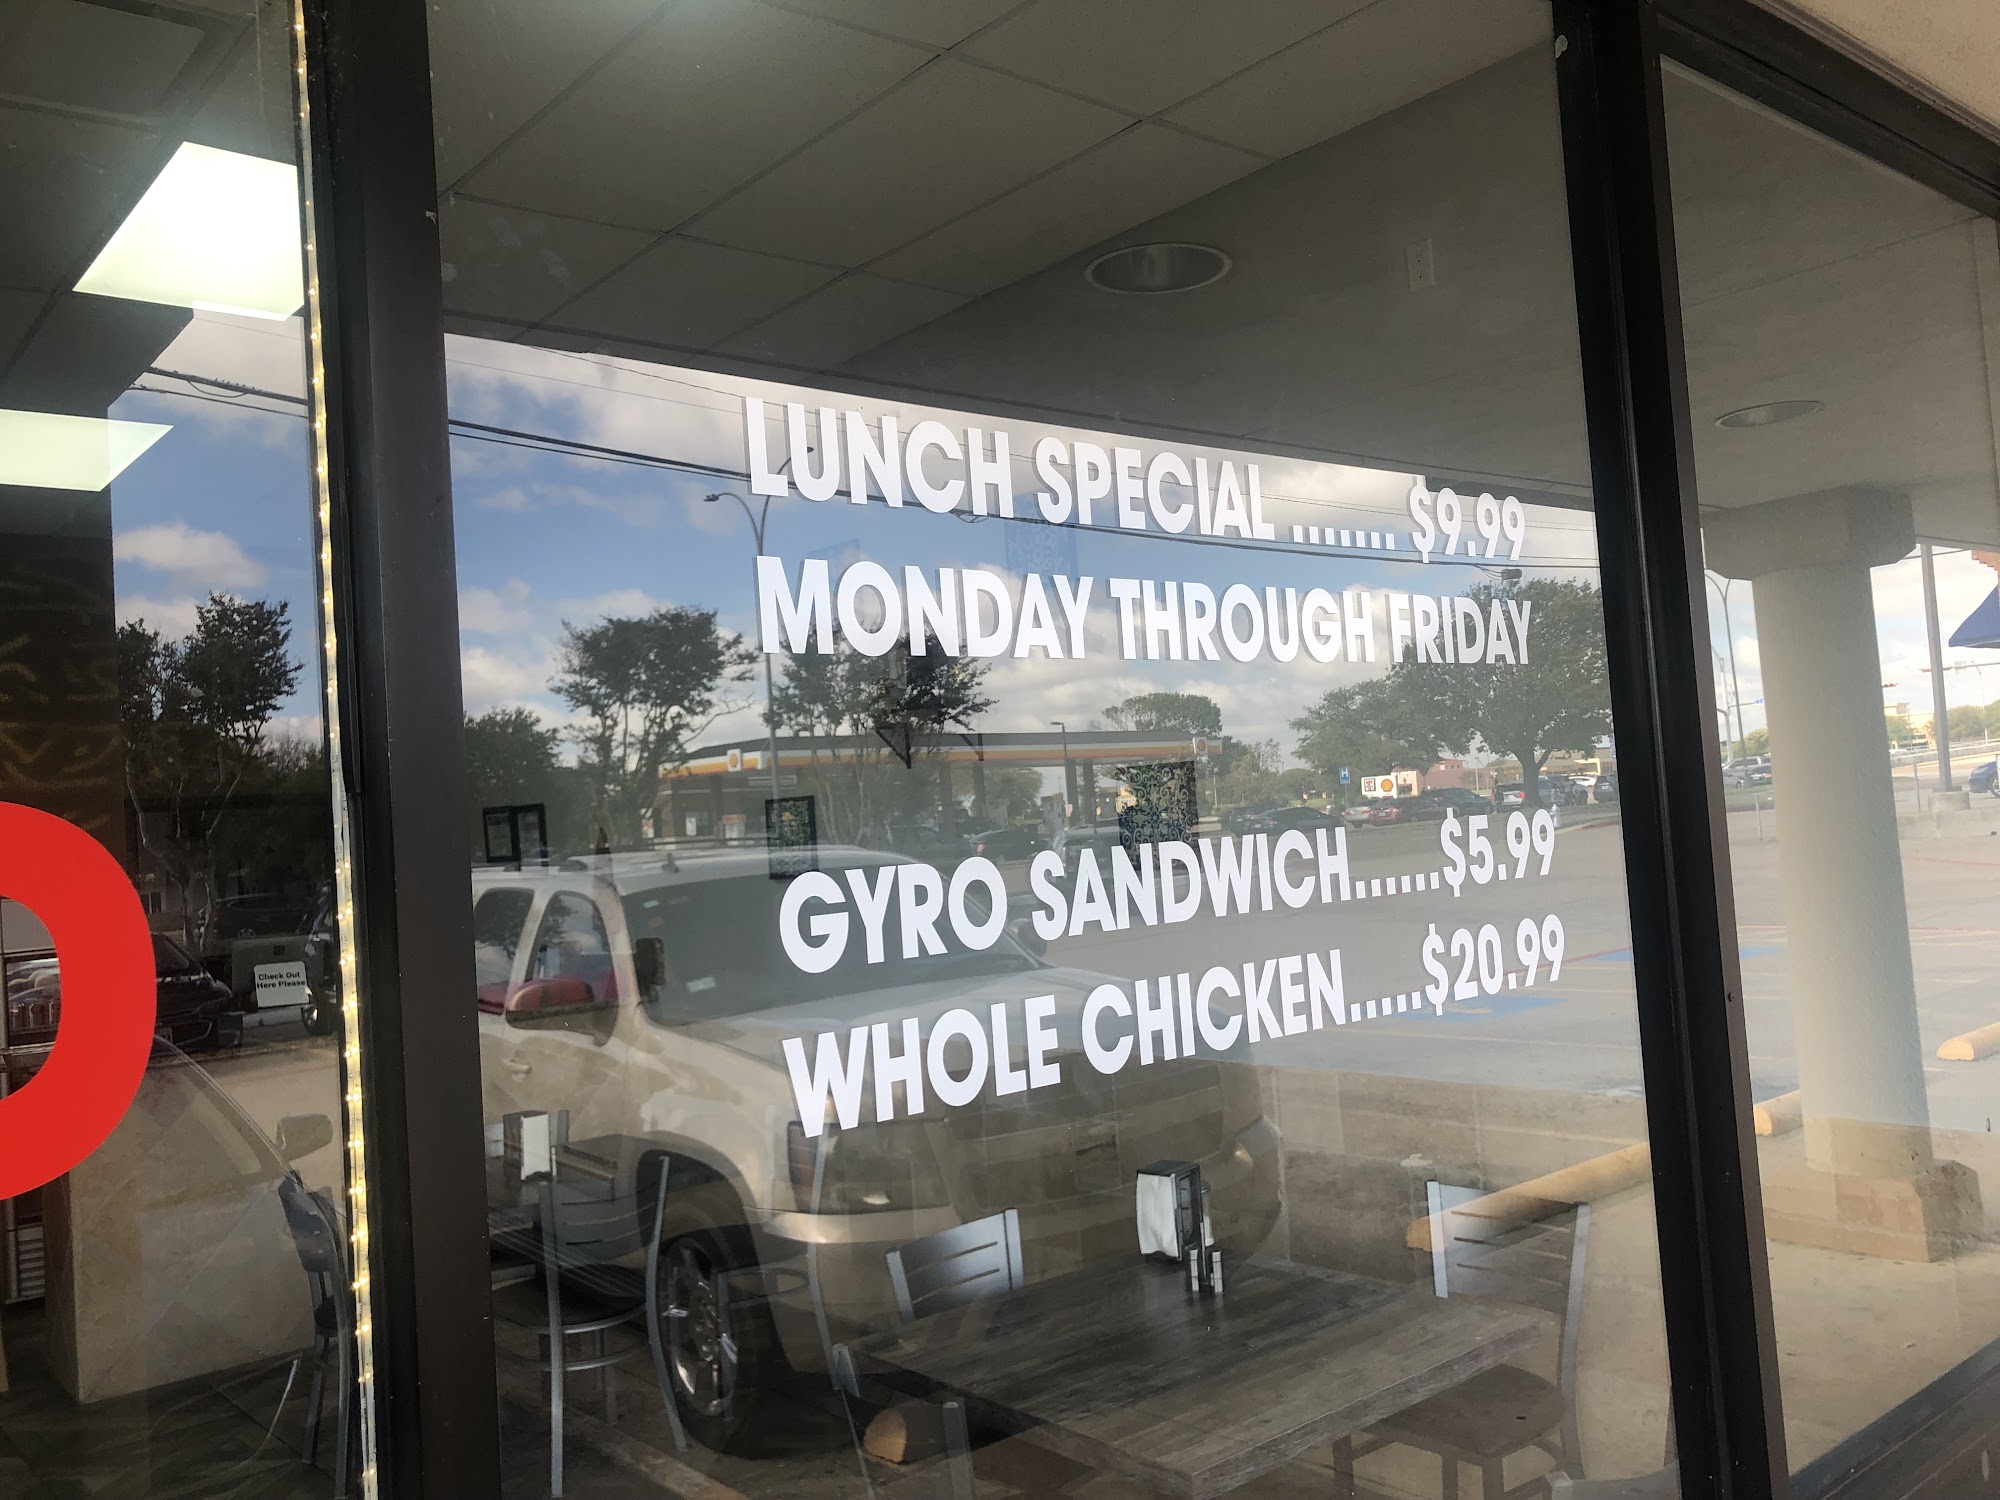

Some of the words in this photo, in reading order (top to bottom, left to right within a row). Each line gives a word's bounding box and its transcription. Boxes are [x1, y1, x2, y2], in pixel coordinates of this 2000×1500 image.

[746, 397, 1013, 518] LUNCH
[1037, 437, 1275, 540] SPECIAL
[1409, 476, 1525, 563] $9.99
[757, 556, 1093, 659] MONDAY
[1110, 577, 1375, 663] THROUGH
[1388, 593, 1531, 664] FRIDAY
[780, 856, 1007, 973] GYRO
[257, 981, 276, 989] Here
[259, 972, 283, 980] Check
[782, 994, 1061, 1138] WHOLE
